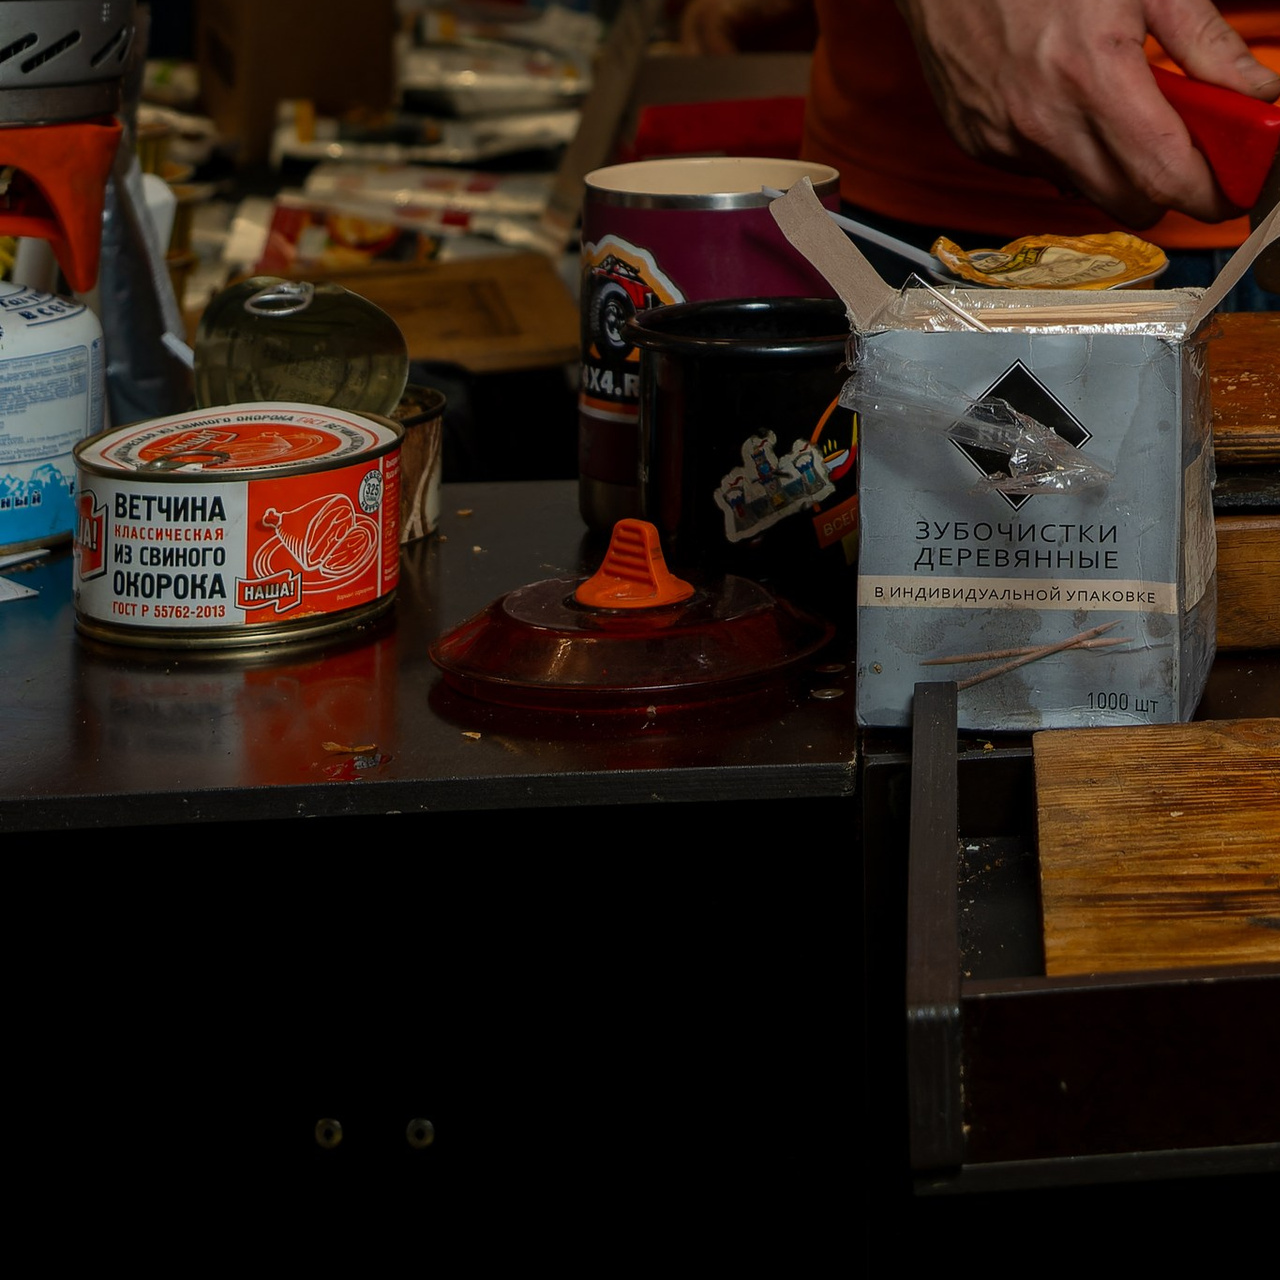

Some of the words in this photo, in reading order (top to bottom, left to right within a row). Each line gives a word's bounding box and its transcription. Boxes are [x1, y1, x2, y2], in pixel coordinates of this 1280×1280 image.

[366, 483, 379, 496] 325
[115, 492, 226, 522] ВЕТЧИНА
[114, 524, 224, 541] КЛАССИЧЕСКАЯ
[915, 521, 1118, 543] ЗУБОЧИСТКИ
[114, 543, 132, 564] ИЗ
[140, 546, 226, 567] СВИНОГО
[914, 547, 1118, 571] ДЕРЕВЯННЫЕ
[113, 570, 227, 599] ОКОРОКА
[244, 580, 294, 601] НАША!
[875, 586, 884, 598] В
[890, 586, 1061, 602] ИНДИВИДУАЛЬНОЙ
[1066, 590, 1156, 604] УПАКОВКЕ
[113, 601, 138, 616] ГОСТ
[142, 605, 149, 617] Р
[154, 605, 226, 618] 55762-2013
[1087, 692, 1128, 711] 1000
[1135, 699, 1159, 713] шт
